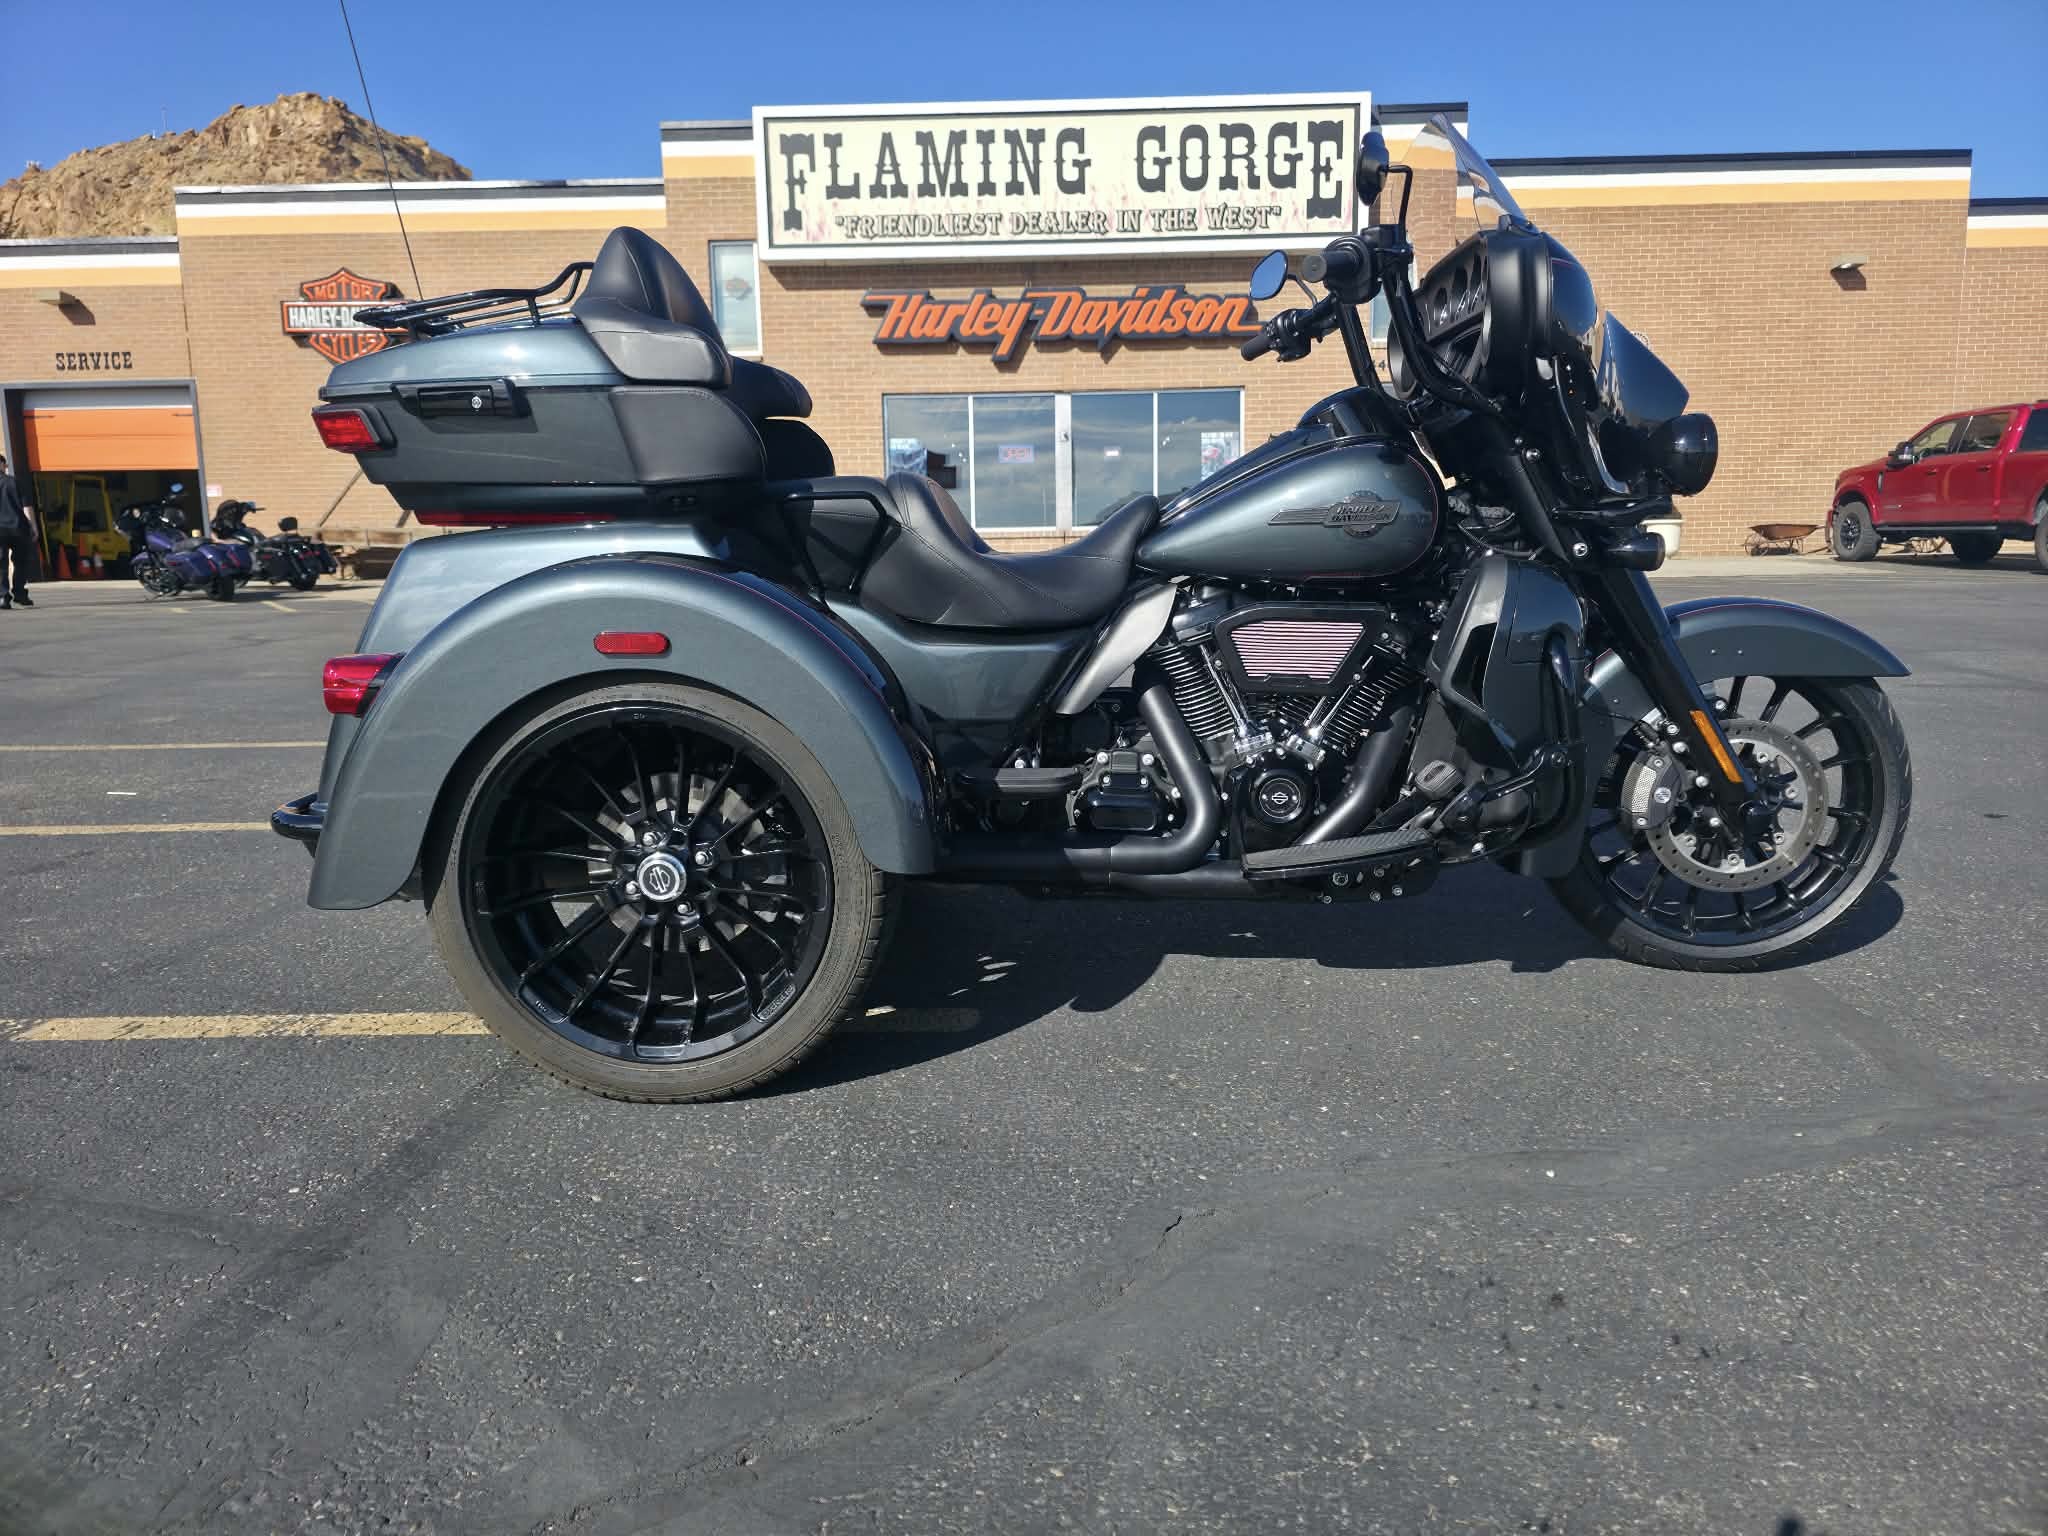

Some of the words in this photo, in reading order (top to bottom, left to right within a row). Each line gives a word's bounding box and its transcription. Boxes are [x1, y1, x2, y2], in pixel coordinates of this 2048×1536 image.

[779, 126, 1092, 231] FLAMING
[1135, 119, 1344, 219] GORGE
[834, 213, 1002, 239] "FRIENDLIEST
[1010, 209, 1109, 235] DEALER
[1115, 209, 1143, 232] IN
[1150, 207, 1198, 231] THE
[1205, 202, 1282, 230] WEST"
[313, 277, 375, 300] MOTOR
[865, 286, 1265, 356] Harley-Davidson
[55, 351, 133, 370] SERVICE
[318, 333, 378, 359] CYCLES
